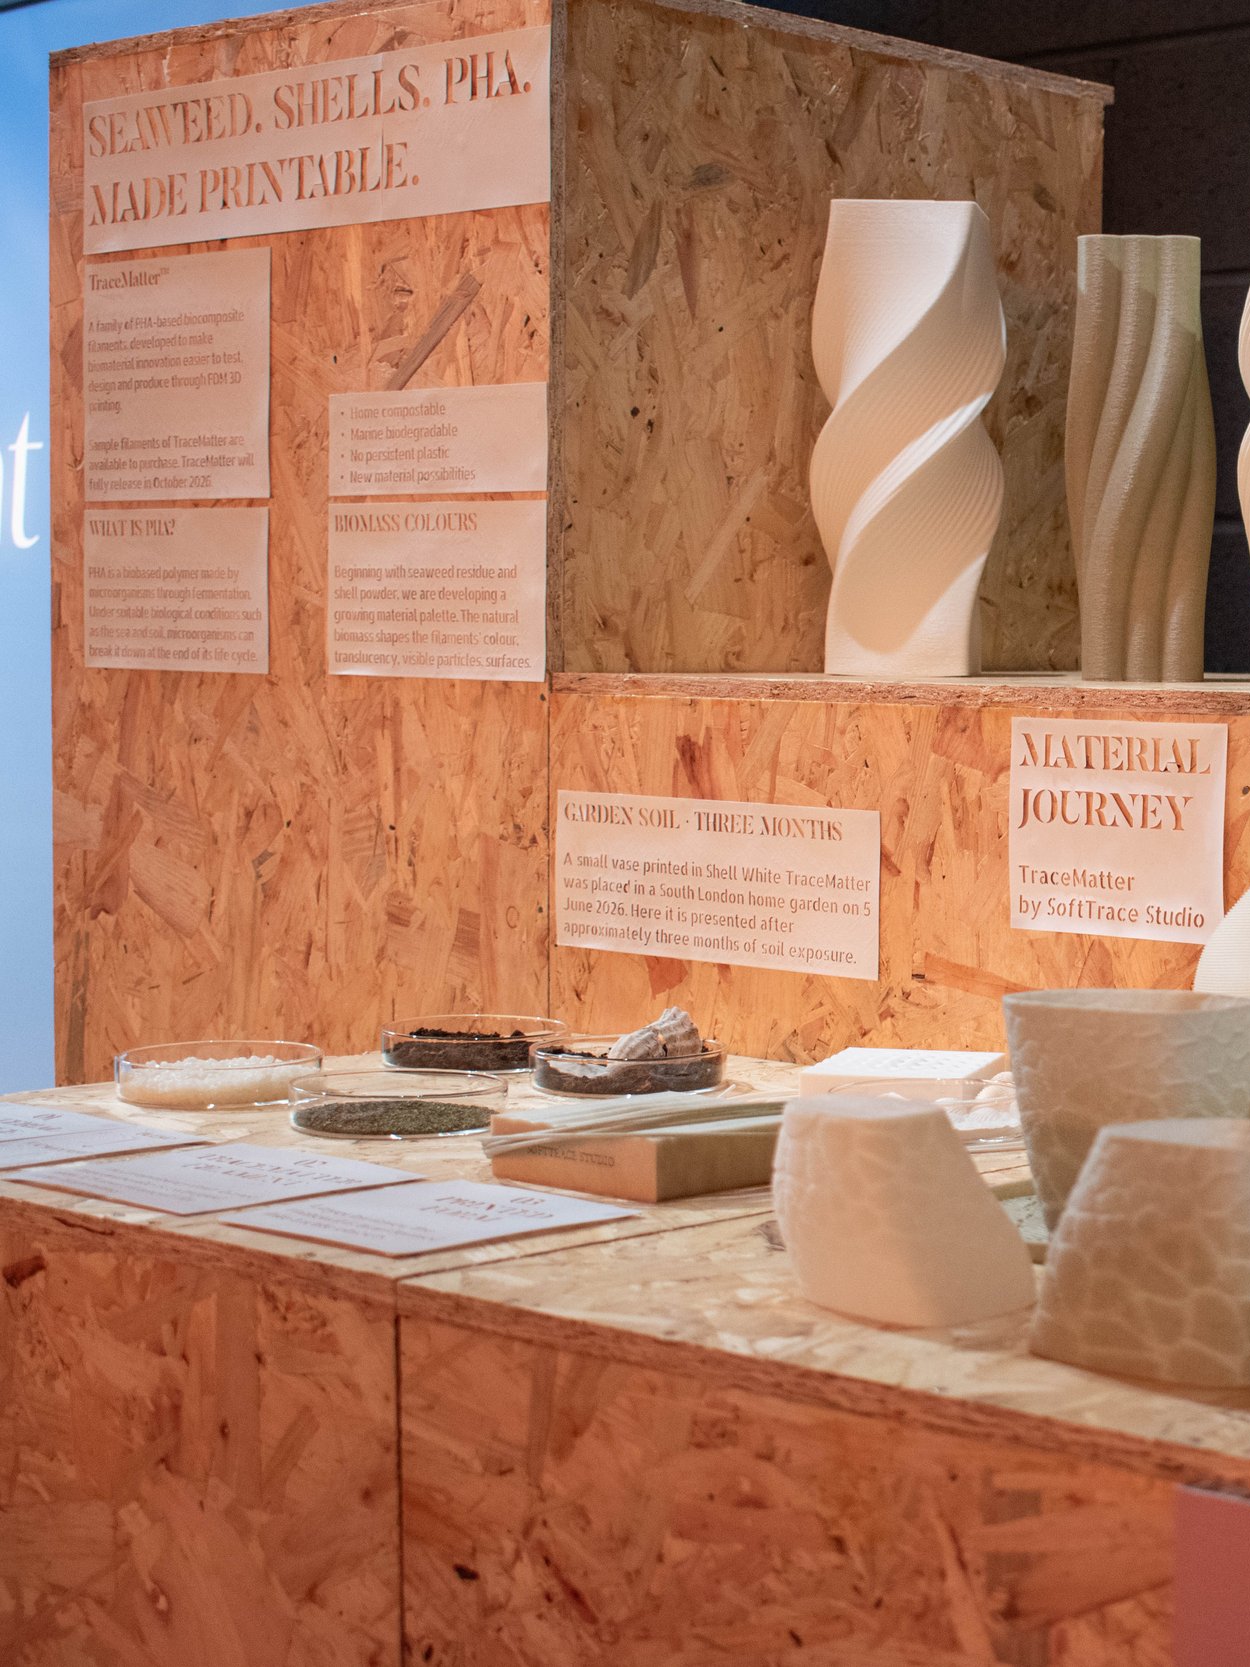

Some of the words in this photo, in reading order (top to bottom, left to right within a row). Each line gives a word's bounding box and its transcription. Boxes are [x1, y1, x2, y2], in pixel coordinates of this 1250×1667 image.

[88, 92, 264, 158] SEAWEED.
[273, 63, 431, 131] SHELLS.
[443, 47, 532, 106] PHA.
[88, 172, 188, 227] MADE
[198, 141, 420, 214] PRINTABLE.
[183, 308, 245, 327] biocomposite
[129, 337, 177, 352] developed
[178, 335, 188, 348] to
[189, 332, 214, 346] make
[211, 352, 221, 365] to
[117, 378, 133, 392] and
[133, 376, 169, 393] produce
[349, 407, 379, 420] Home
[381, 401, 447, 420] compostable
[161, 435, 171, 449] of
[228, 434, 245, 446] are
[349, 426, 384, 441] Marine
[385, 423, 459, 443] biodegradable
[349, 448, 364, 463] No
[365, 447, 415, 465] persistent
[416, 445, 450, 464] plastic
[349, 470, 373, 484] New
[373, 468, 416, 484] material
[416, 465, 477, 486] possibilities
[89, 519, 126, 537] WHAT
[129, 519, 143, 537] IS
[333, 513, 401, 533] BIOMASS
[404, 512, 479, 533] COLOURS
[162, 566, 199, 583] polymer
[227, 567, 240, 583] by
[334, 564, 383, 583] Beginning
[384, 564, 407, 580] with
[407, 564, 456, 580] seaweed
[456, 563, 496, 580] residue
[497, 564, 518, 580] and
[334, 586, 359, 601] shell
[401, 589, 418, 601] we
[419, 588, 437, 602] are
[438, 585, 499, 605] developing
[500, 590, 507, 601] a
[241, 607, 262, 622] such
[333, 607, 376, 625] growing
[376, 608, 418, 624] material
[460, 608, 481, 625] The
[481, 609, 521, 626] natural
[334, 628, 375, 644] biomass
[375, 629, 411, 648] shapes
[412, 630, 430, 645] the
[172, 647, 190, 661] end
[401, 650, 436, 667] visible
[1018, 732, 1212, 776] MATERIAL
[1017, 788, 1195, 832] JOURNEY
[563, 801, 634, 826] GARDEN
[638, 807, 681, 830] SOIL
[693, 810, 755, 836] THREE
[759, 815, 844, 842] MONTHS
[563, 851, 573, 866] A
[576, 853, 609, 870] small
[611, 857, 641, 873] vase
[642, 858, 689, 877] printed
[691, 861, 703, 878] in
[706, 863, 738, 882] Shell
[741, 866, 782, 885] White
[785, 869, 872, 892] TraceMatter
[1018, 864, 1136, 892] TraceMatter
[563, 876, 590, 890] was
[590, 876, 631, 895] placed
[633, 879, 646, 896] in
[648, 884, 657, 897] a
[659, 882, 696, 901] South
[697, 885, 746, 906] London
[748, 890, 786, 909] home
[789, 896, 839, 915] garden
[842, 902, 860, 916] on
[863, 901, 872, 917] 5
[562, 896, 594, 914] June
[595, 899, 629, 918] 2026.
[630, 902, 662, 921] Here
[665, 905, 674, 922] it
[676, 906, 688, 923] is
[690, 911, 757, 931] presented
[759, 916, 796, 934] after
[1018, 894, 1042, 920] by
[1046, 896, 1140, 924] SoftTrace
[1145, 904, 1206, 929] Studio
[563, 920, 653, 946] approximately
[655, 928, 690, 946] three
[692, 934, 740, 953] months
[742, 938, 758, 954] of
[760, 940, 786, 958] soil
[788, 945, 858, 966] exposure.
